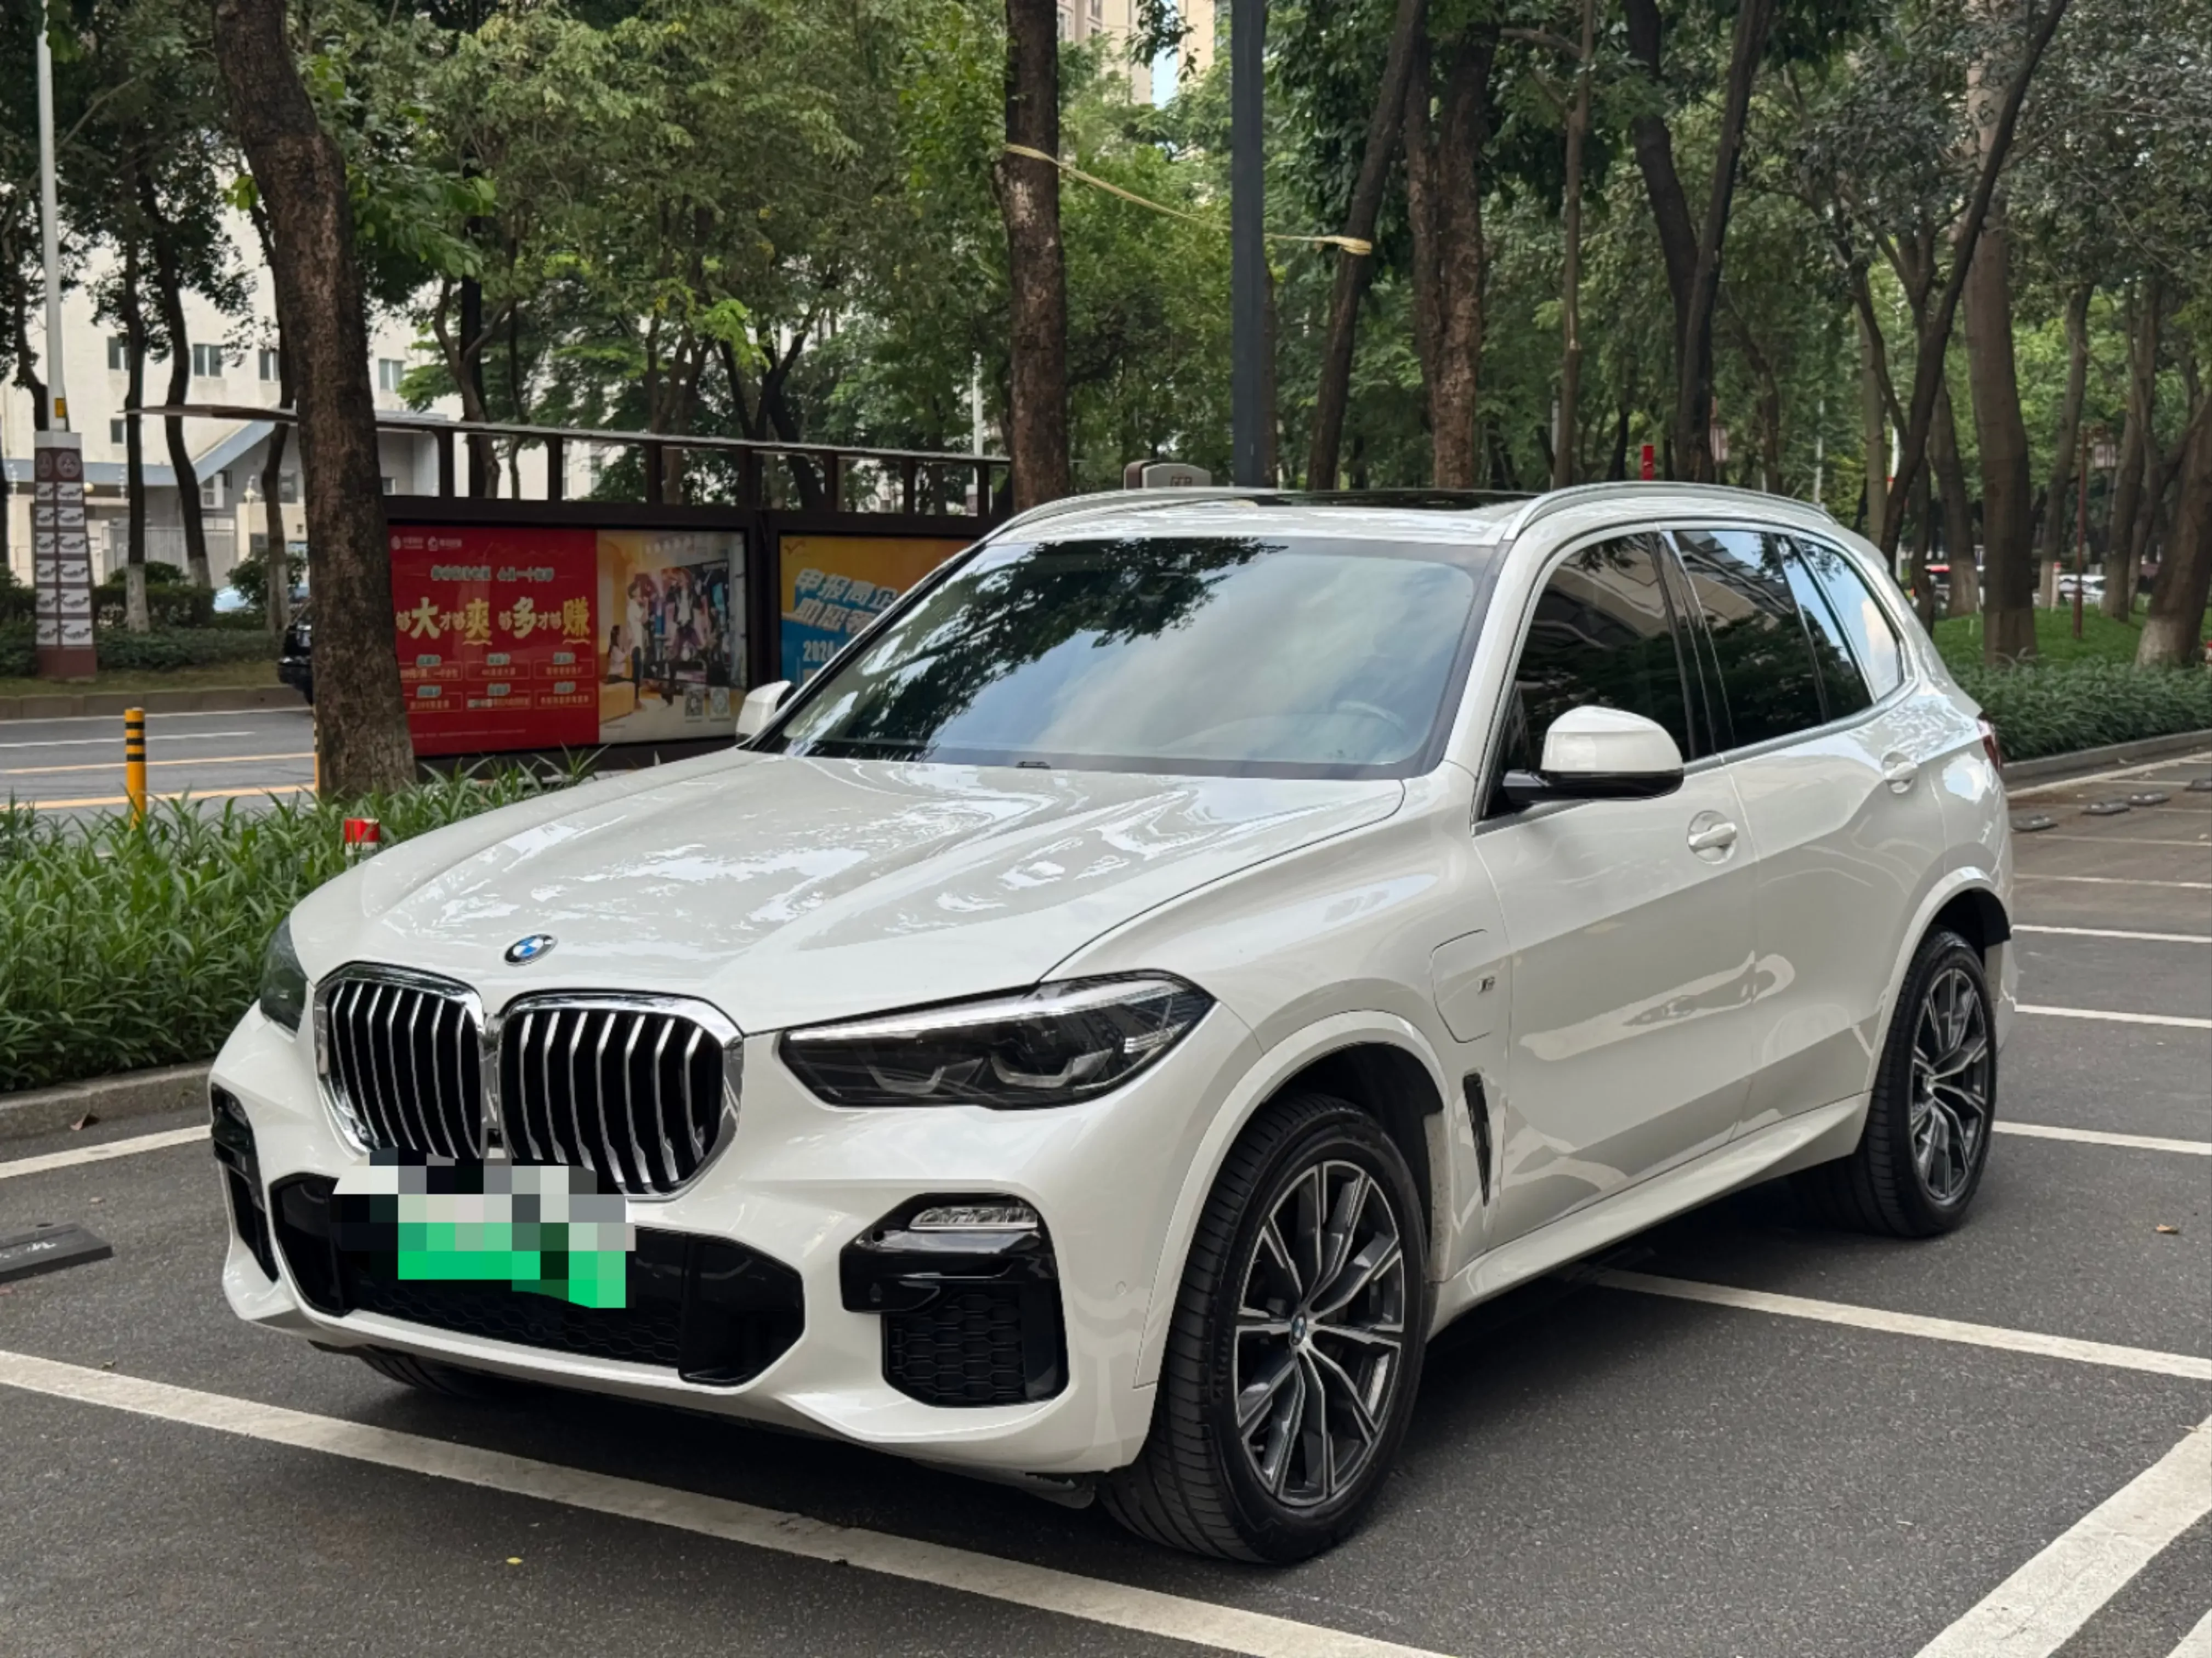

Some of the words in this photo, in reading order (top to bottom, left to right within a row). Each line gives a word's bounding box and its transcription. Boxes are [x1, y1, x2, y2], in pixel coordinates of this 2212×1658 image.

[396, 597, 492, 639] 够大才够爽
[498, 596, 591, 639] 够多才够赚
